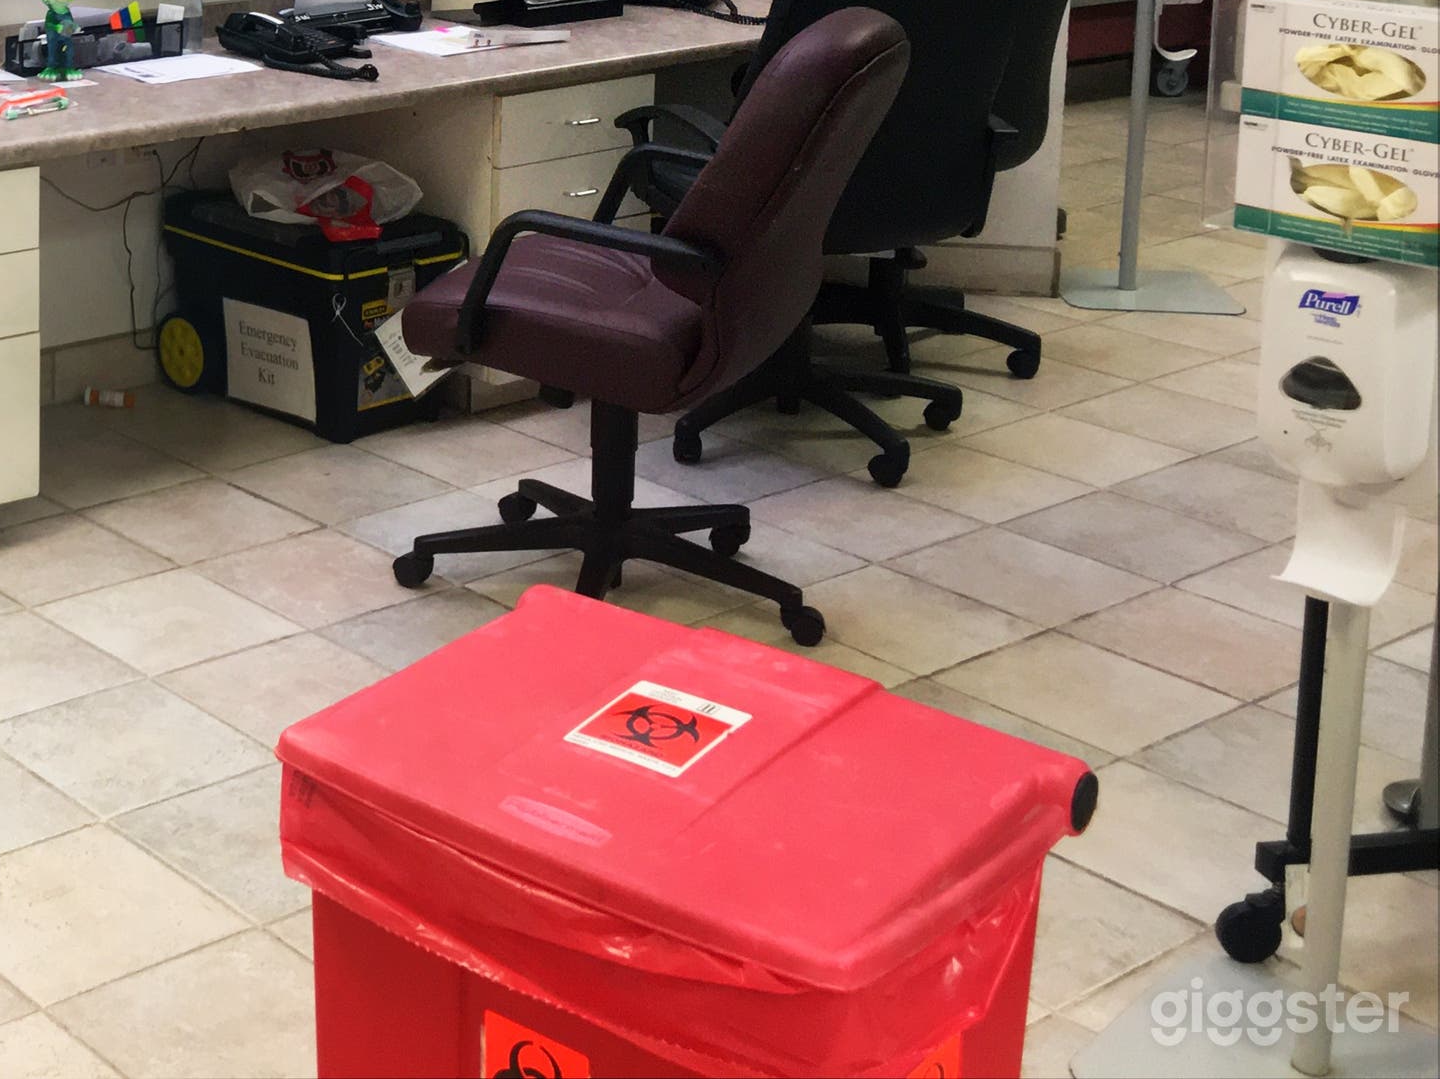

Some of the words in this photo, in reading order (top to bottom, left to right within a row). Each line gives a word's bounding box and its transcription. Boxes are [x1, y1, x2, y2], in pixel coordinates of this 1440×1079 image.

[1304, 292, 1352, 315] Purell
[239, 320, 297, 352] Emergency
[240, 341, 299, 370] Evacuation
[258, 367, 276, 385] Kit
